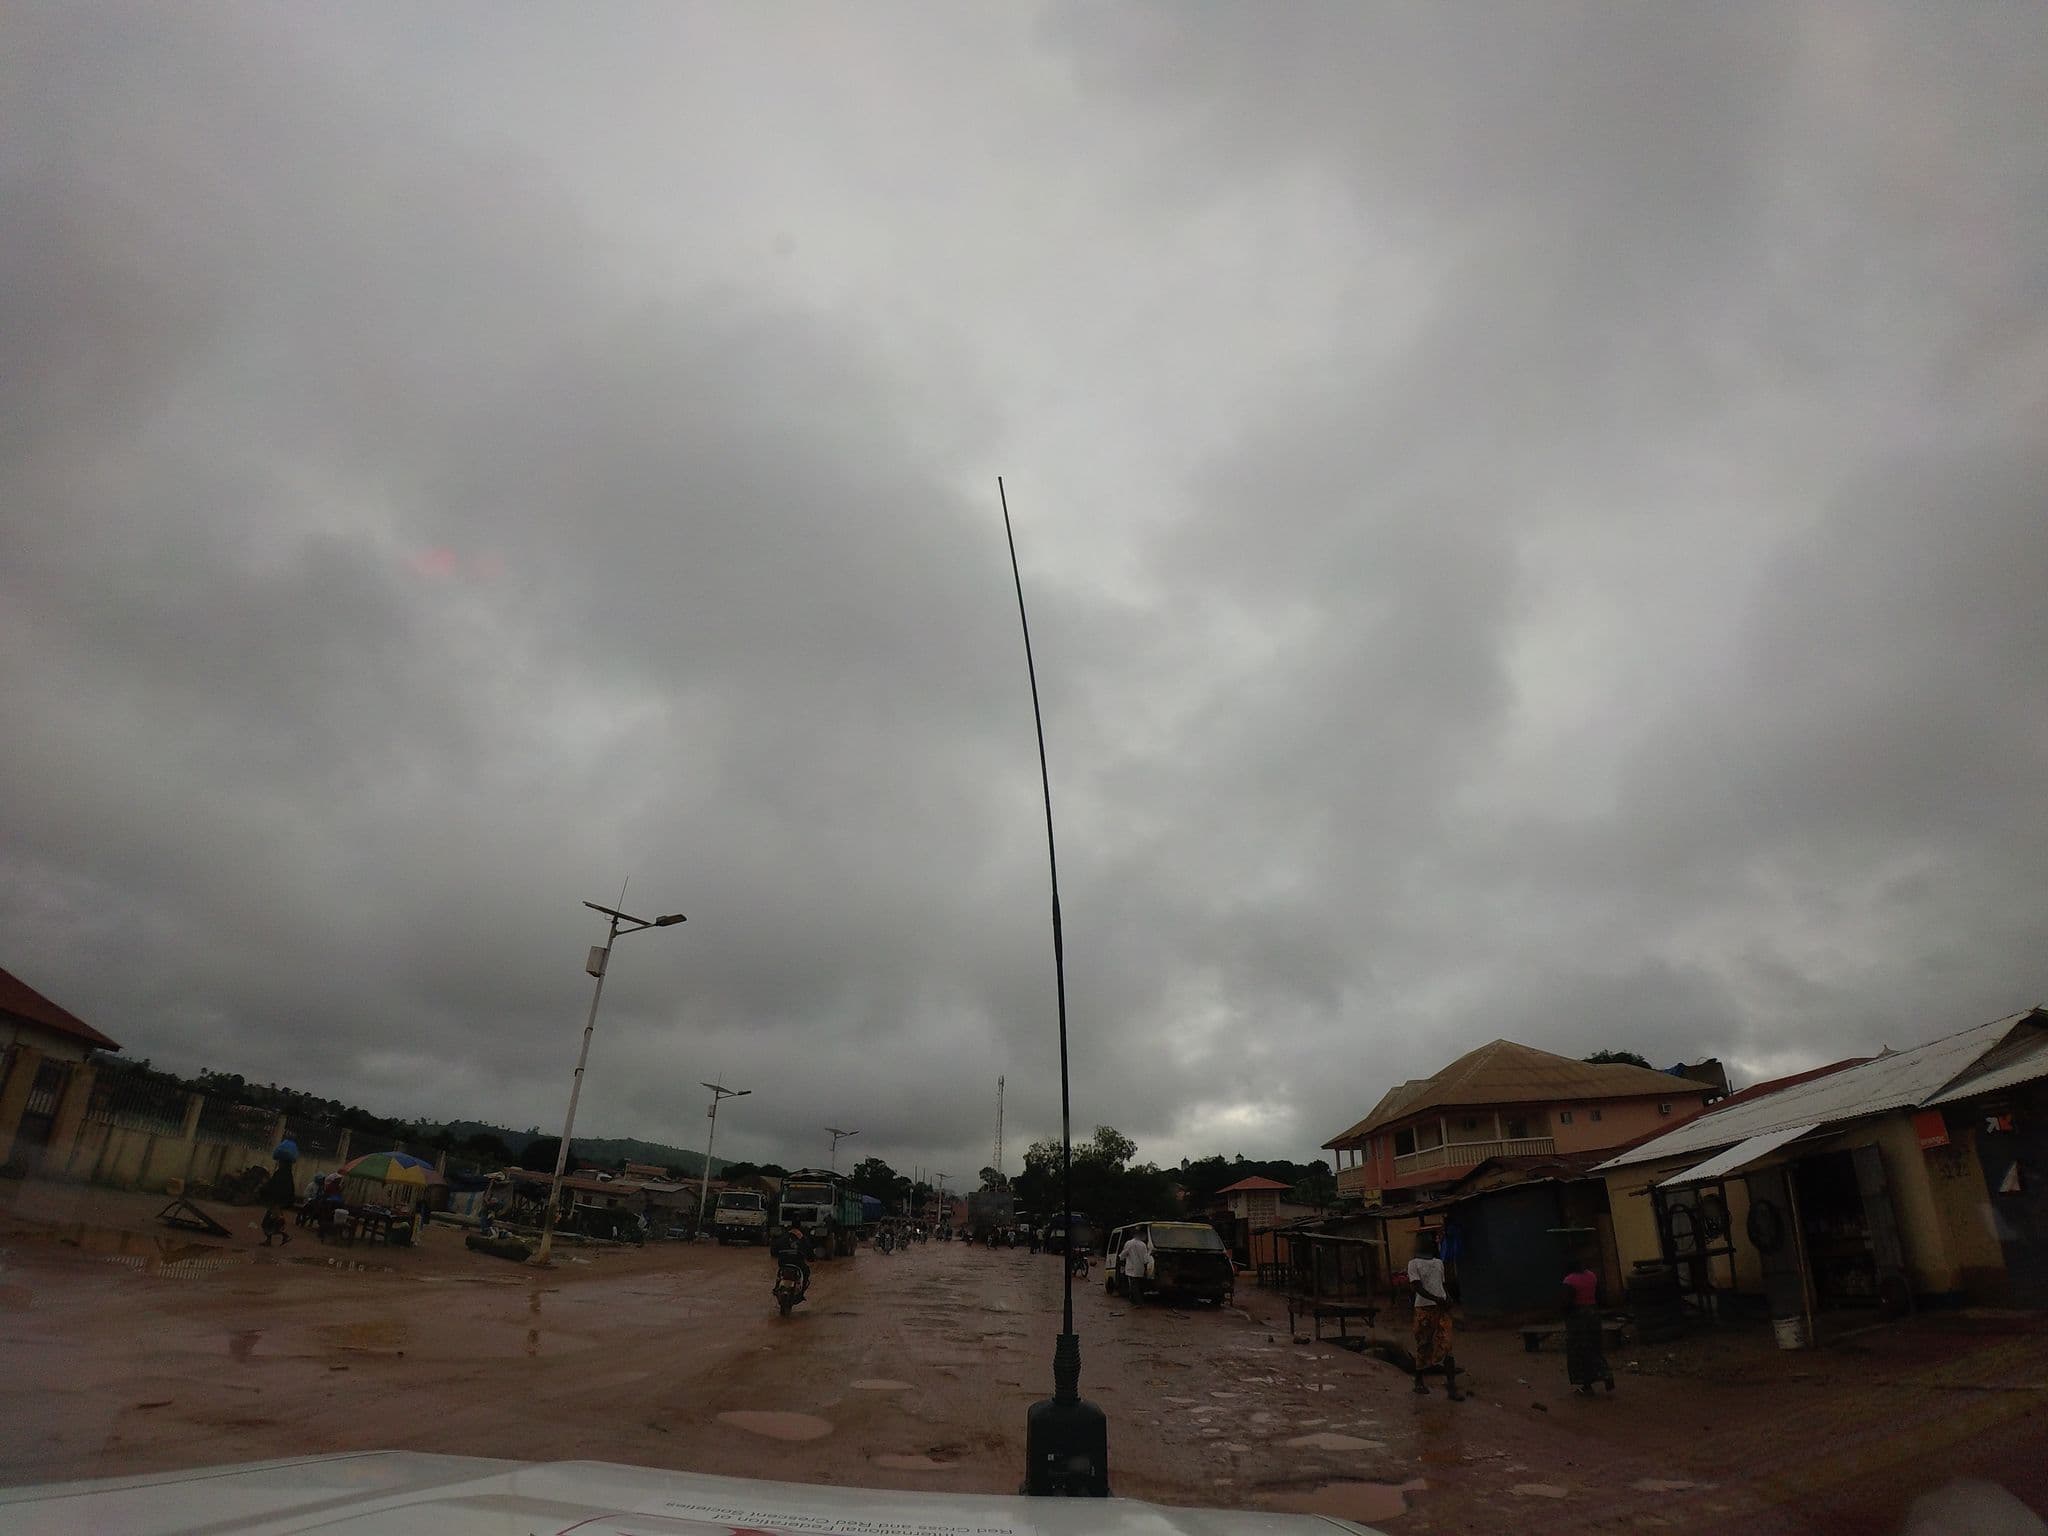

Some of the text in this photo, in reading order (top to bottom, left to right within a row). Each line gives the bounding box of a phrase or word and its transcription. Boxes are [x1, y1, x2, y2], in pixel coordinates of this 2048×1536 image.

[665, 1502, 745, 1516] Societies
[750, 1511, 830, 1524] Crescent
[737, 1516, 835, 1531] Federation
[836, 1519, 871, 1528] Red
[918, 1525, 970, 1533] Cross
[976, 1527, 1012, 1535] Red
